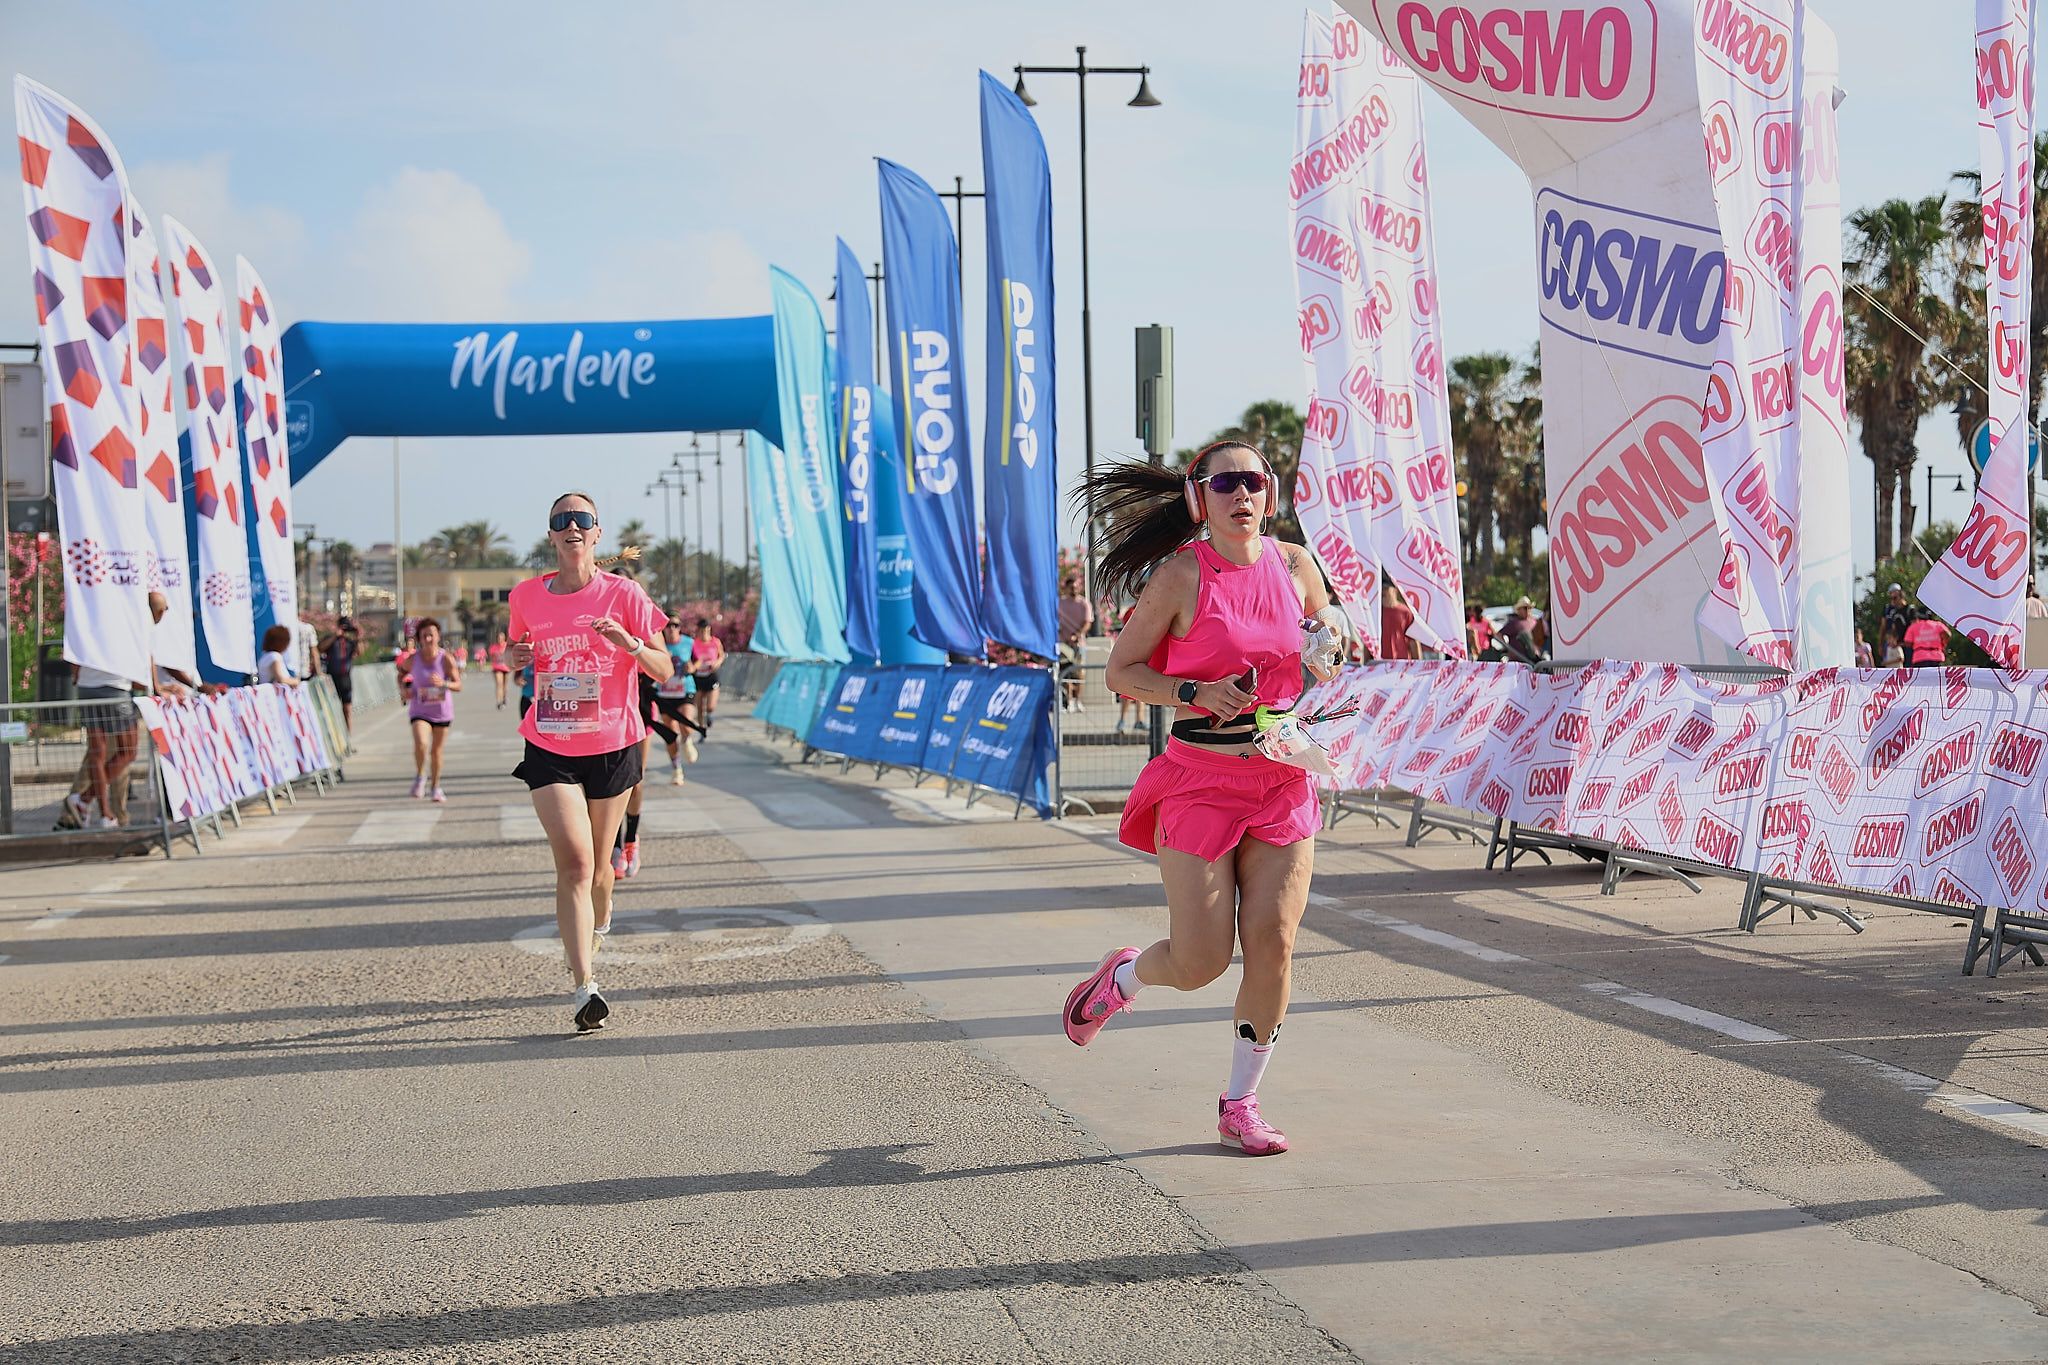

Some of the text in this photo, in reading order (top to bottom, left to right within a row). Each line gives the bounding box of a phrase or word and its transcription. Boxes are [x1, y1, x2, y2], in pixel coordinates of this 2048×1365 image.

[1397, 2, 1632, 100] COSMO
[1541, 209, 1726, 344] COSMO
[450, 329, 656, 420] Marlene
[1551, 420, 1711, 618] COSMO
[553, 700, 579, 711] 016
[986, 680, 1030, 720] GOYA
[1602, 695, 1645, 750] COSMO
[1629, 714, 1672, 758] COSMO
[1674, 717, 1715, 754] COSMO
[1790, 734, 1820, 771] COS
[1872, 708, 1924, 781] COSMO
[1921, 730, 1975, 789] COSMO
[1989, 728, 2043, 778] COSMO
[1480, 779, 1511, 818] COSMO
[1529, 765, 1574, 798] COSM
[1618, 765, 1660, 810] COSMO
[1719, 754, 1766, 797] COSMO
[1695, 815, 1739, 867] COSMO
[1854, 820, 1905, 859] COSMO
[1926, 797, 1980, 857] COSMO
[1992, 816, 2032, 897] COSMO
